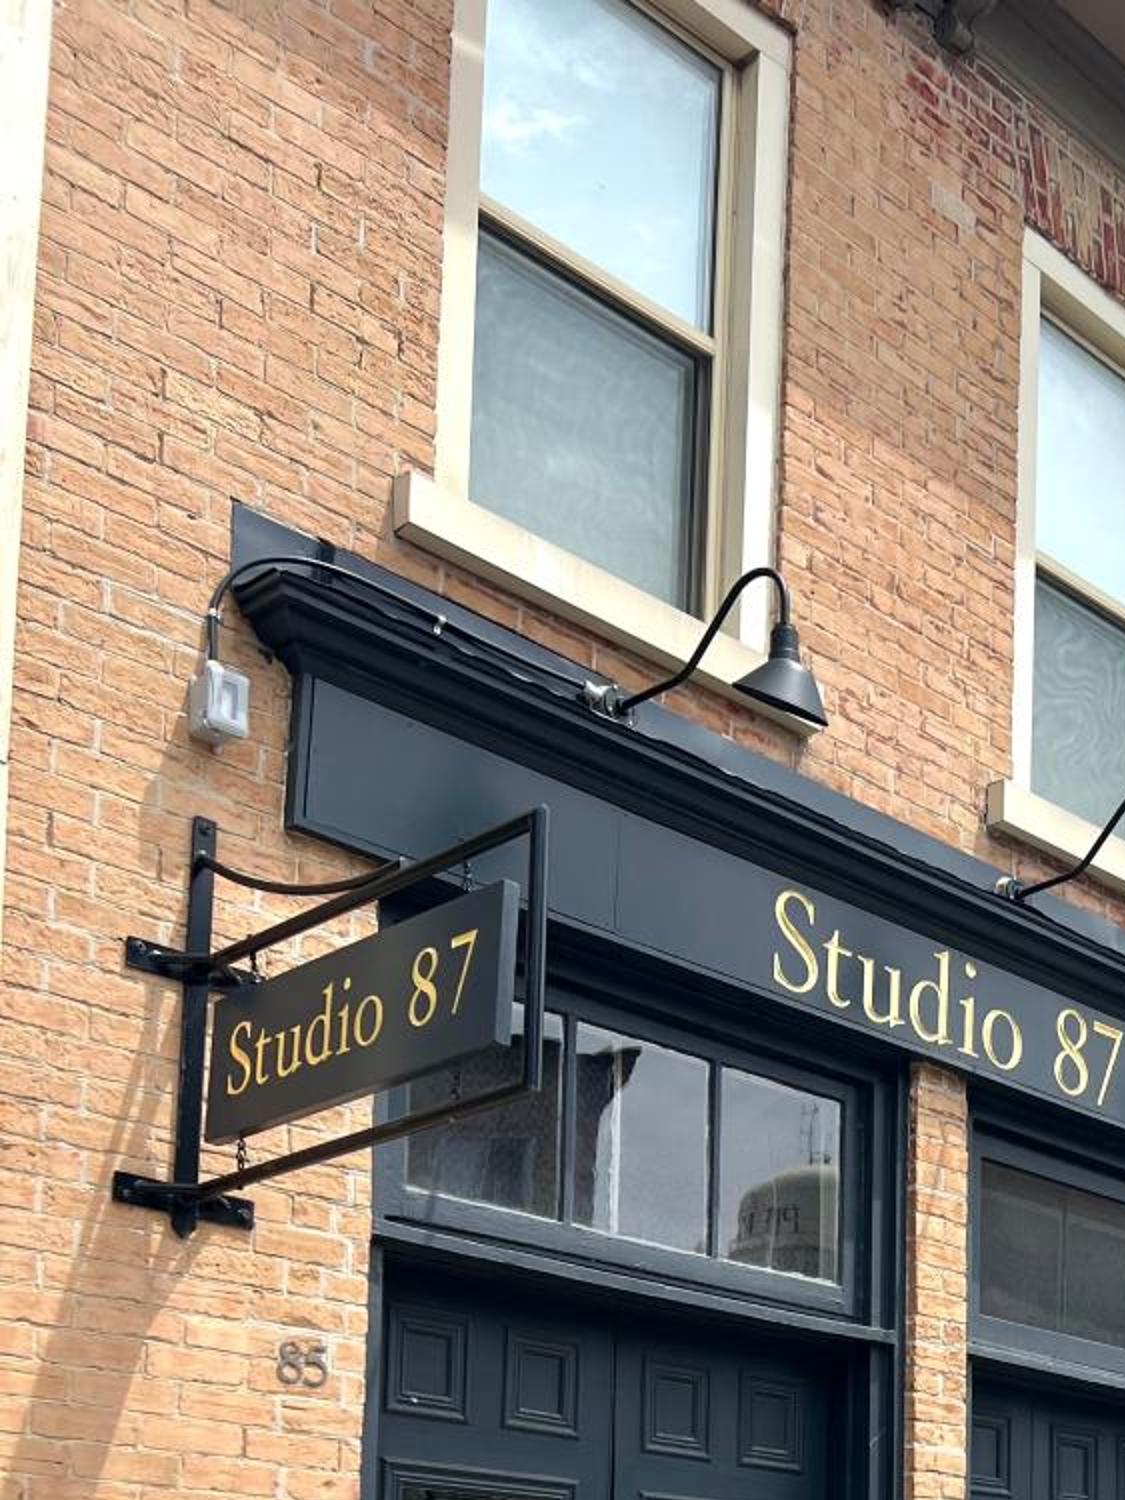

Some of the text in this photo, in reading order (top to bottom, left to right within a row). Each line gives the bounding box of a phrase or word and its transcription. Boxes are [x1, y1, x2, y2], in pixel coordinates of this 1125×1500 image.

[226, 928, 479, 1096] Studio 87
[773, 888, 1124, 1106] Studio 87
[276, 1341, 328, 1388] 85
